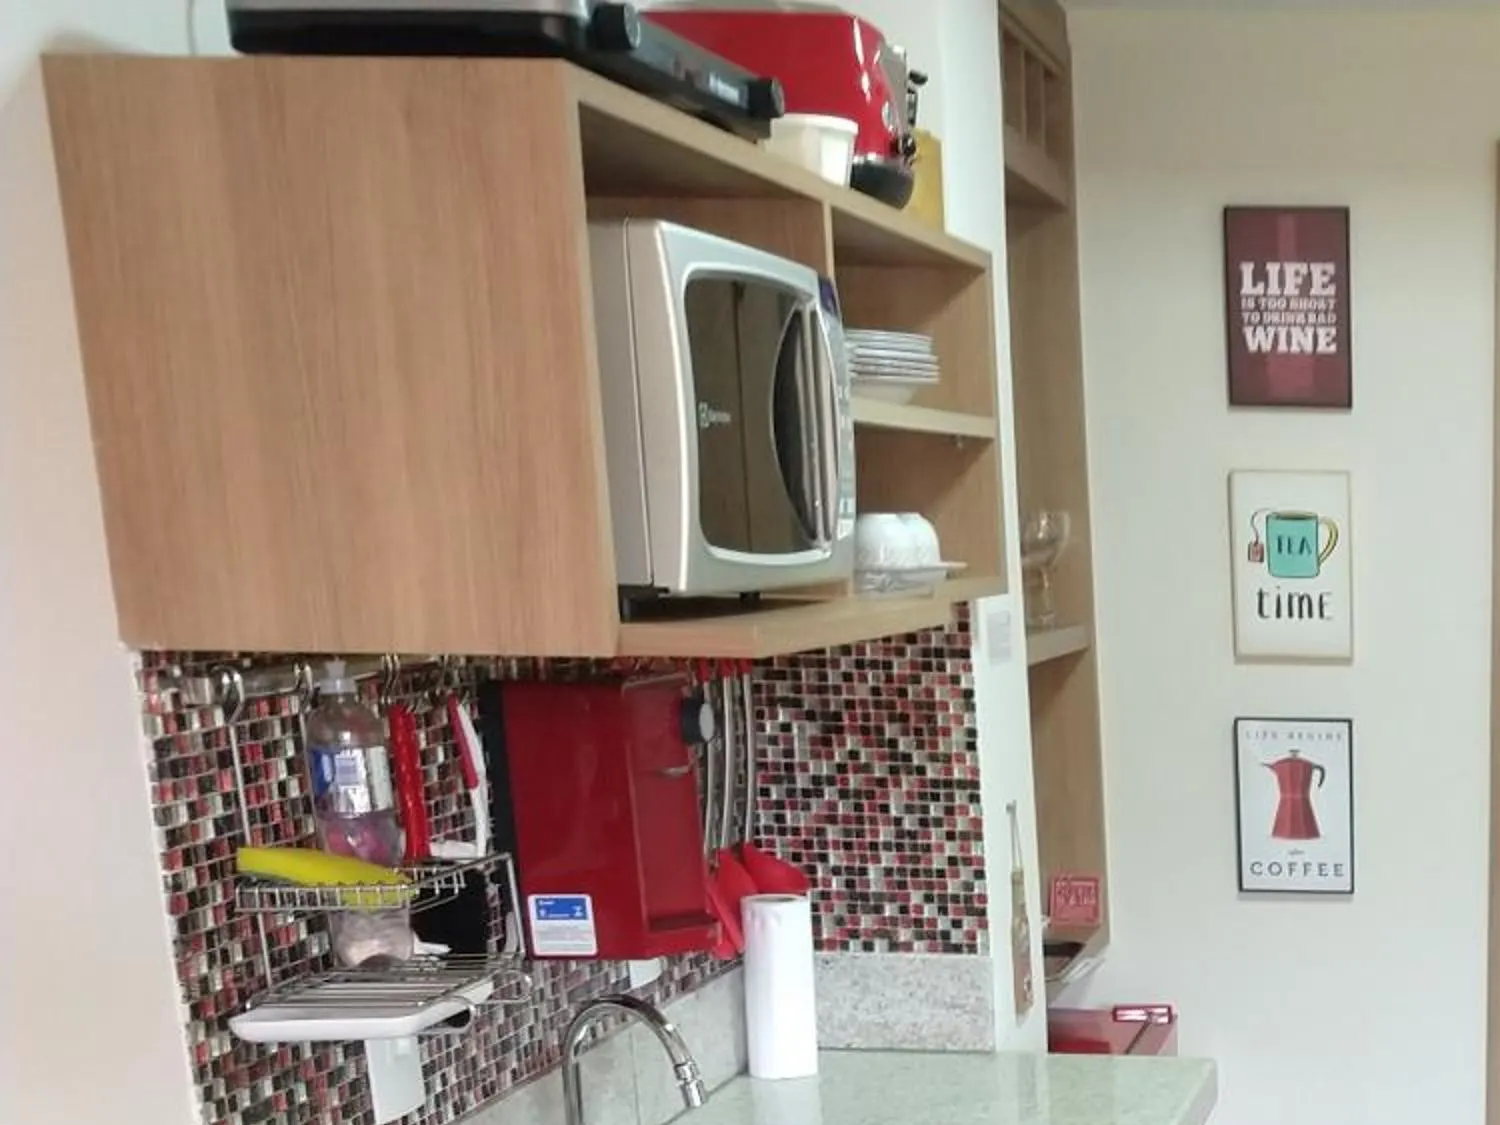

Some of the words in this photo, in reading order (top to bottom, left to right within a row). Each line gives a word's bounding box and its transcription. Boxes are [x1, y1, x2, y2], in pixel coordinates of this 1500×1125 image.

[1240, 262, 1336, 297] LIFE
[1258, 297, 1288, 311] TOO
[1242, 311, 1261, 326] TO
[1243, 325, 1337, 354] WINE
[1249, 860, 1345, 878] COFFEE
